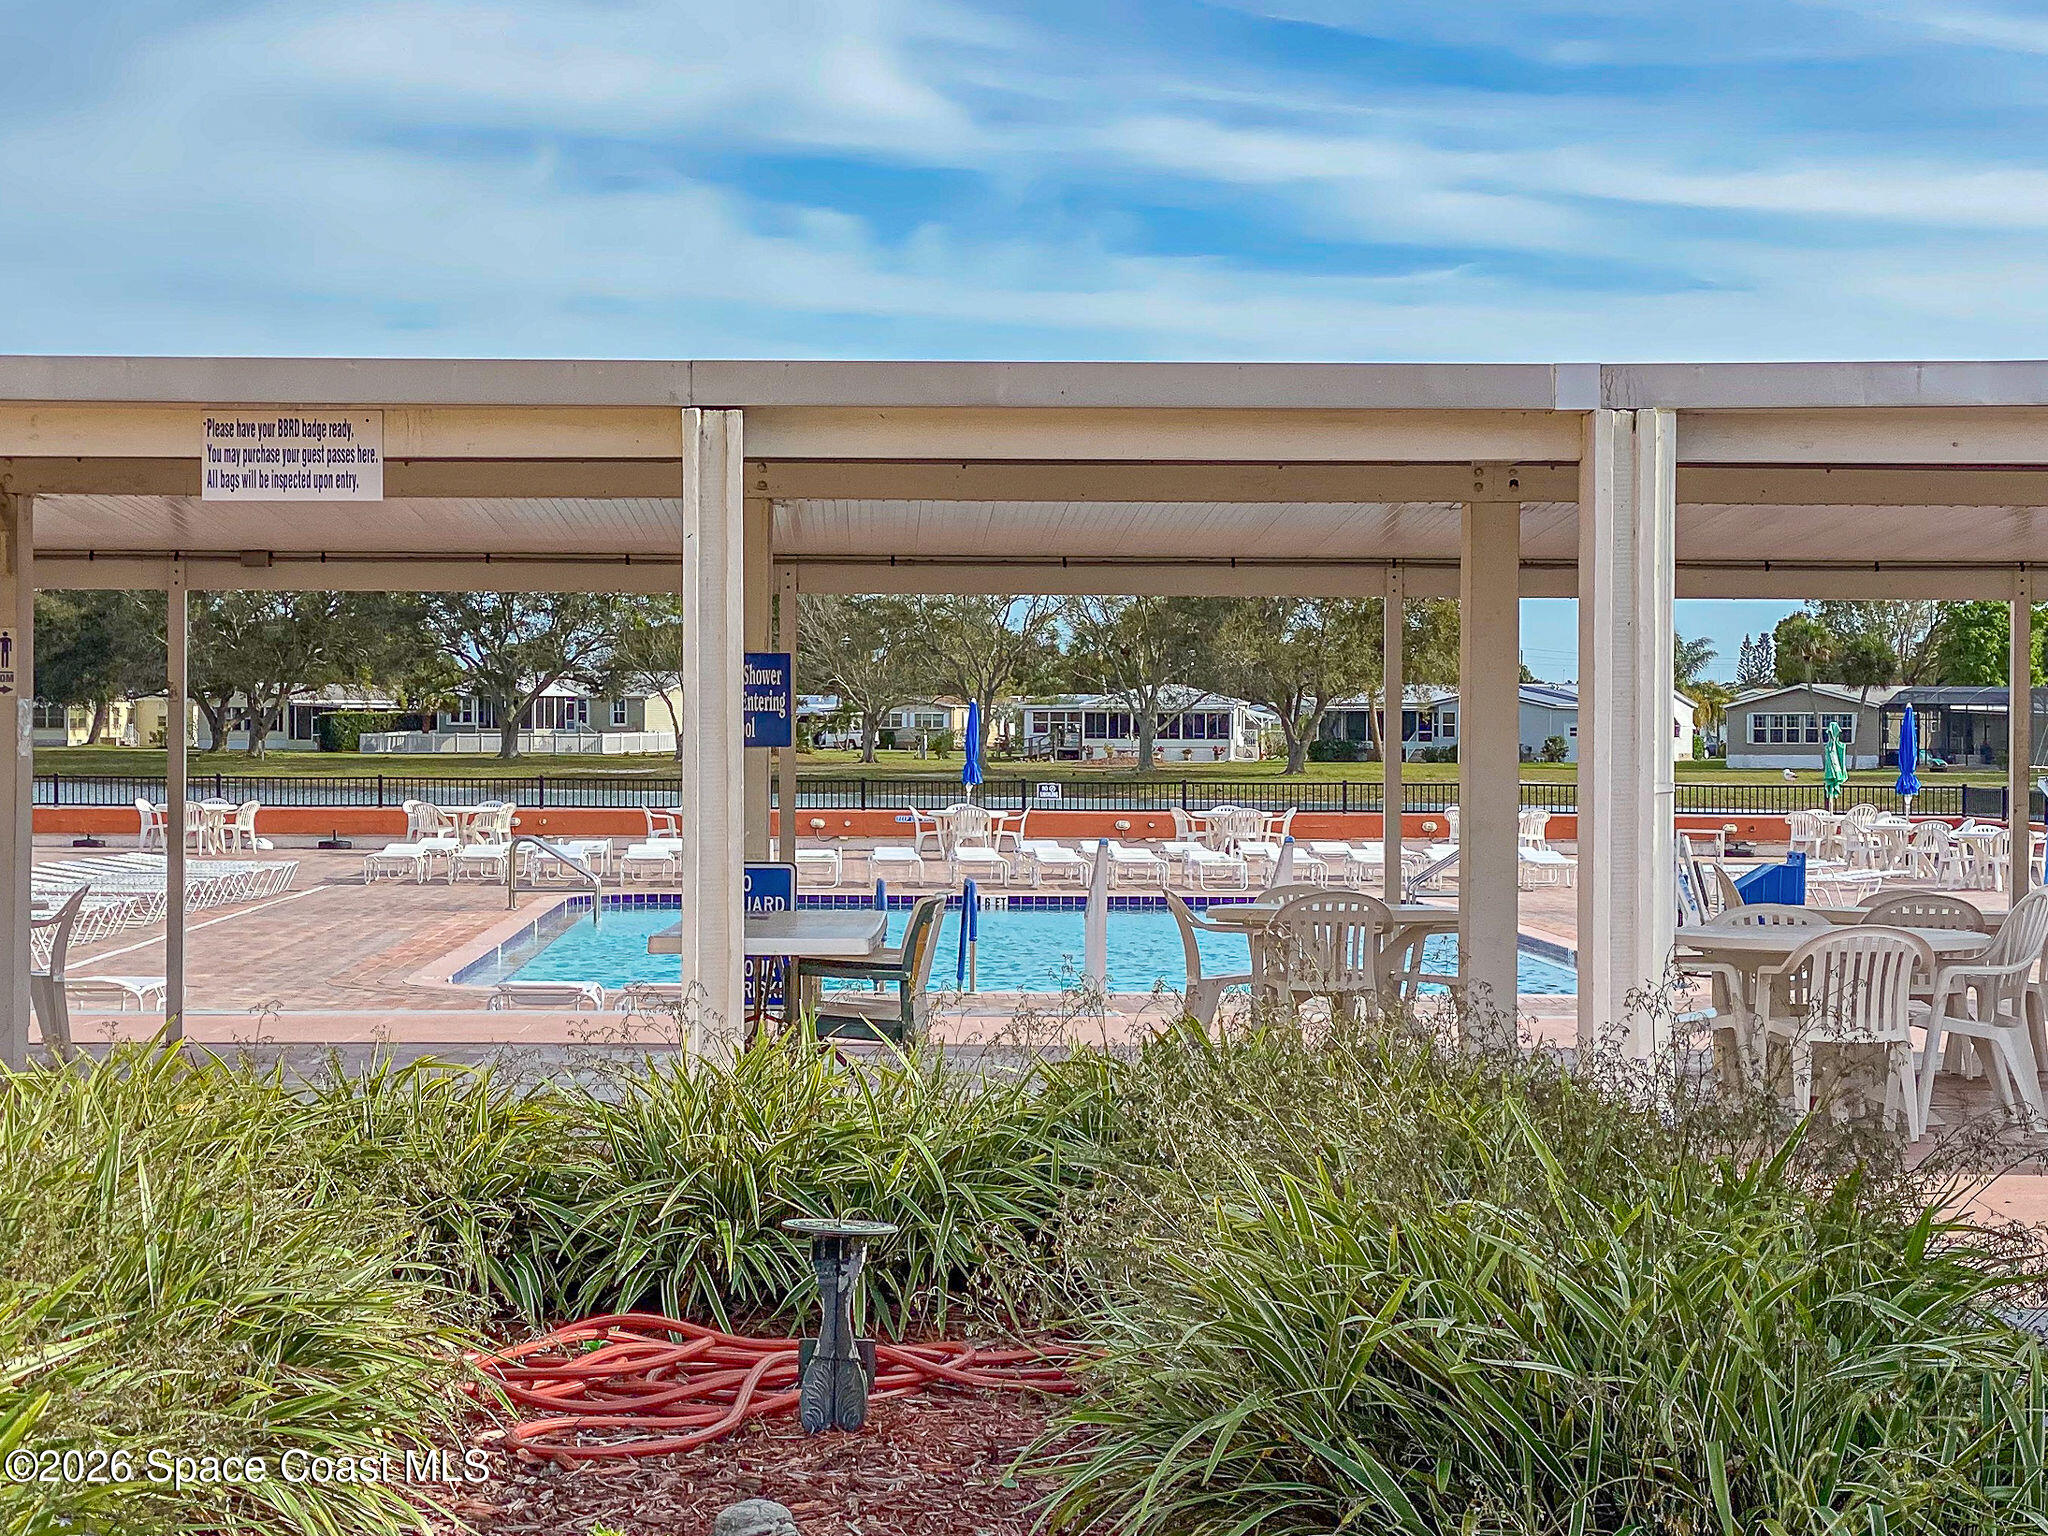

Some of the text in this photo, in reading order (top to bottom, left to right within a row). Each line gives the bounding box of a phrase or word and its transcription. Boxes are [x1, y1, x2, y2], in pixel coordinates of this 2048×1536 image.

[206, 418, 354, 442] Please have your BBRD badge ready.
[206, 444, 378, 468] You may purchase your guest passes here.
[206, 469, 359, 493] All bags will be inspected upon entry.
[743, 663, 782, 685] Shower
